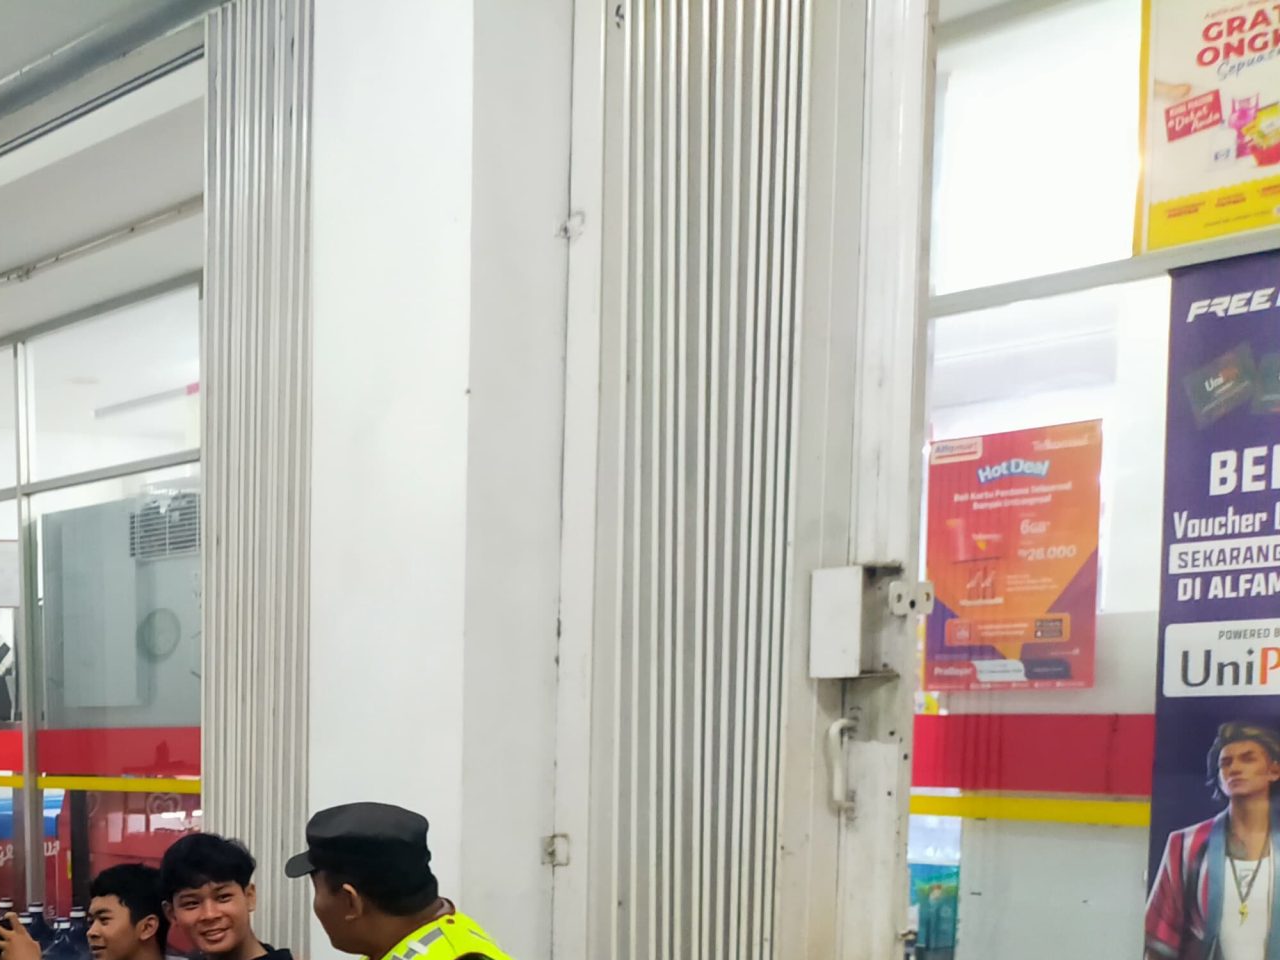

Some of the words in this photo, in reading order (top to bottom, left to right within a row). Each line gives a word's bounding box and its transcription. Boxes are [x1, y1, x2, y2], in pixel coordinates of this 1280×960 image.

[1186, 287, 1275, 323] FREE
[978, 462, 1009, 483] Hot
[1011, 459, 1050, 476] Deal
[1173, 506, 1267, 540] Voucher
[1178, 576, 1201, 602] DI
[1218, 628, 1271, 641] POWERED
